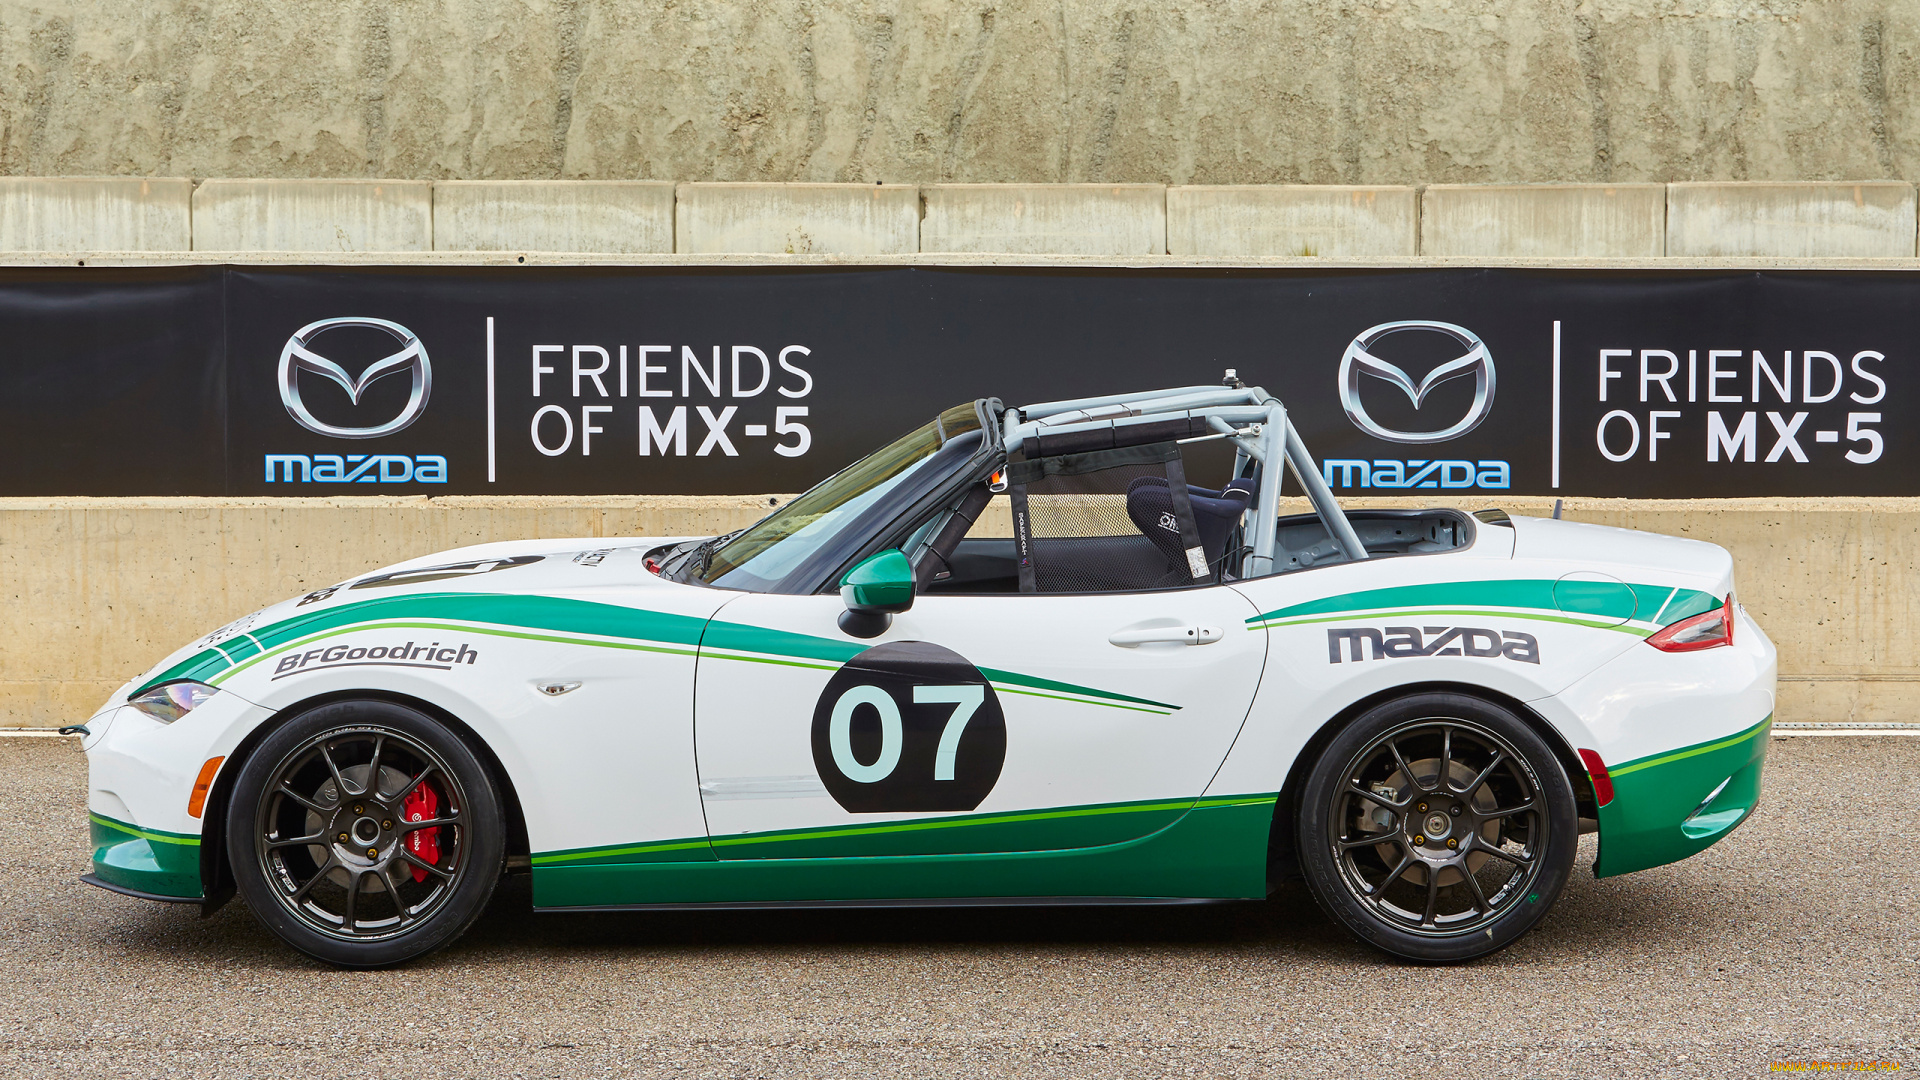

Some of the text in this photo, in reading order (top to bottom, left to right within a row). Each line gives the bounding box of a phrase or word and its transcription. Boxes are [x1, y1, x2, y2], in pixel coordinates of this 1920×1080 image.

[533, 344, 813, 398] FRIENDS
[1599, 348, 1887, 404] FRIENDS
[531, 404, 812, 458] OF MX-5
[1597, 409, 1884, 465] OF MX-5
[273, 641, 478, 675] BFGoodrich
[829, 684, 986, 784] 07
